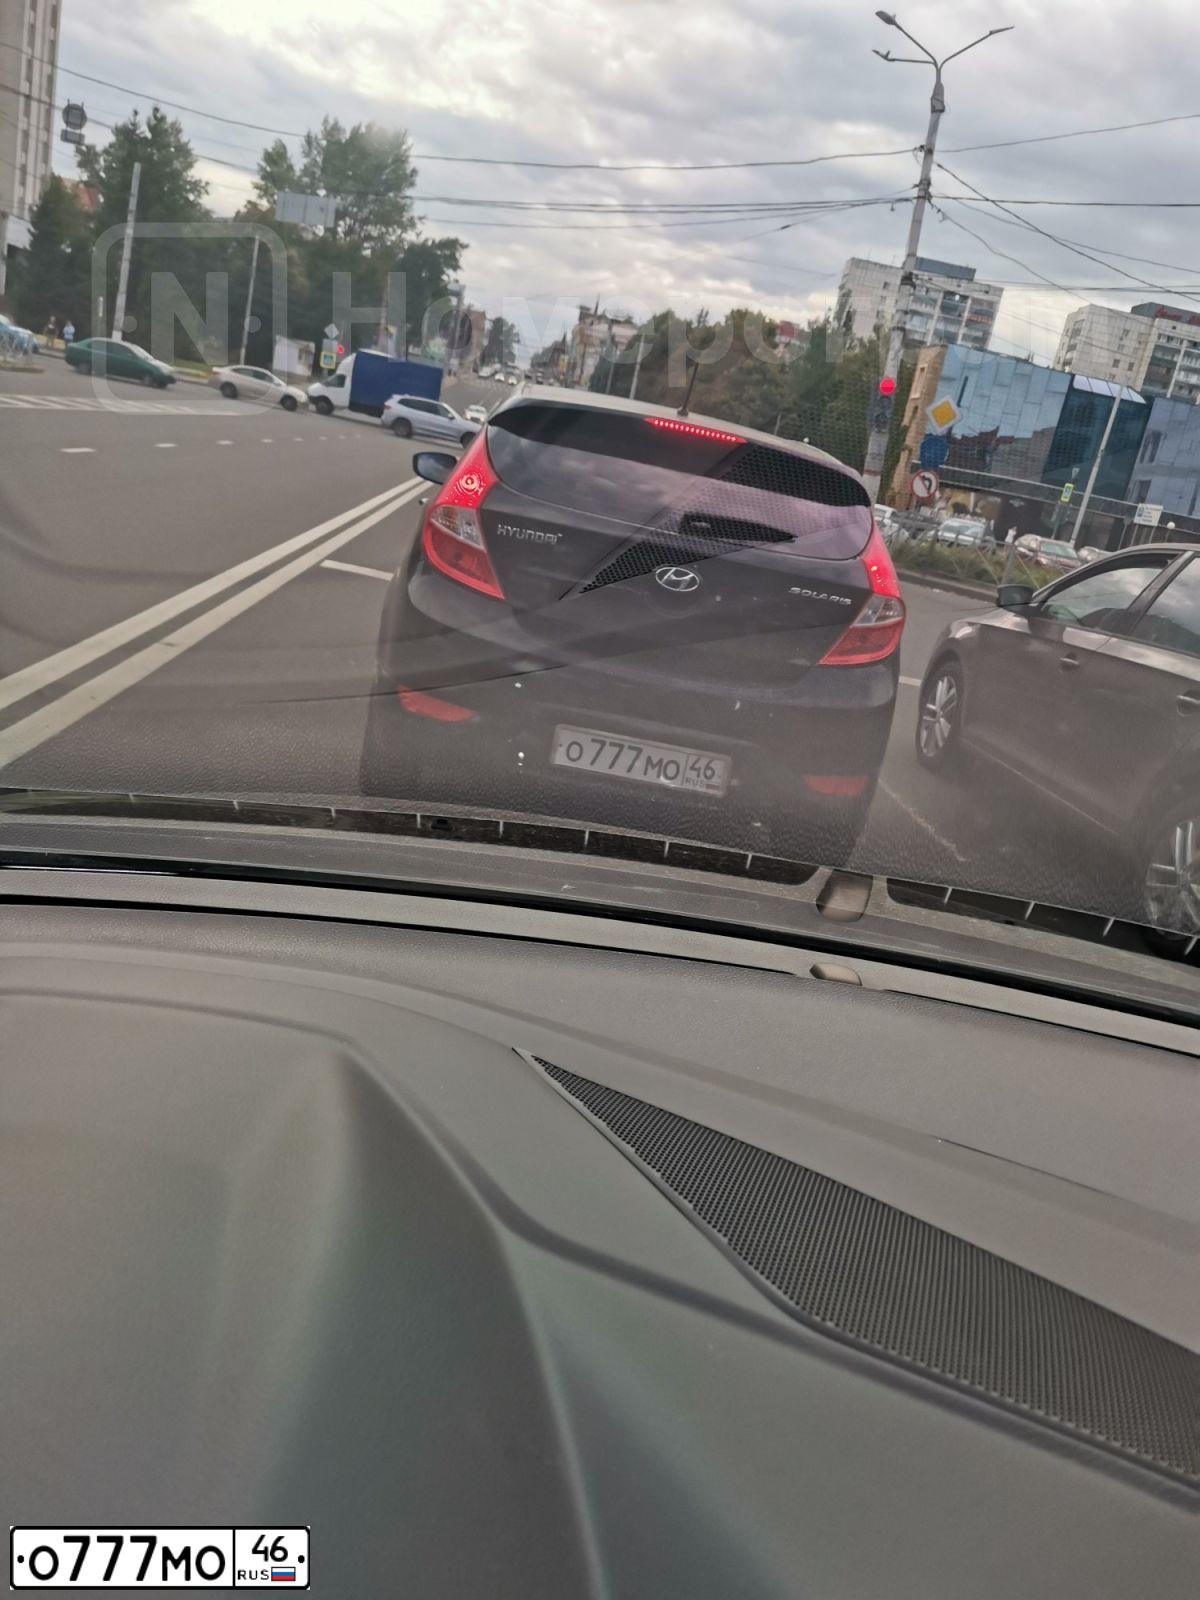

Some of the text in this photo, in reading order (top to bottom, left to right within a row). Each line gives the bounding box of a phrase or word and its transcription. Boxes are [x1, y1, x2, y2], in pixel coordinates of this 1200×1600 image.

[497, 523, 563, 545] HYUNDAI
[788, 586, 852, 606] SOLARIS
[689, 756, 715, 780] 46
